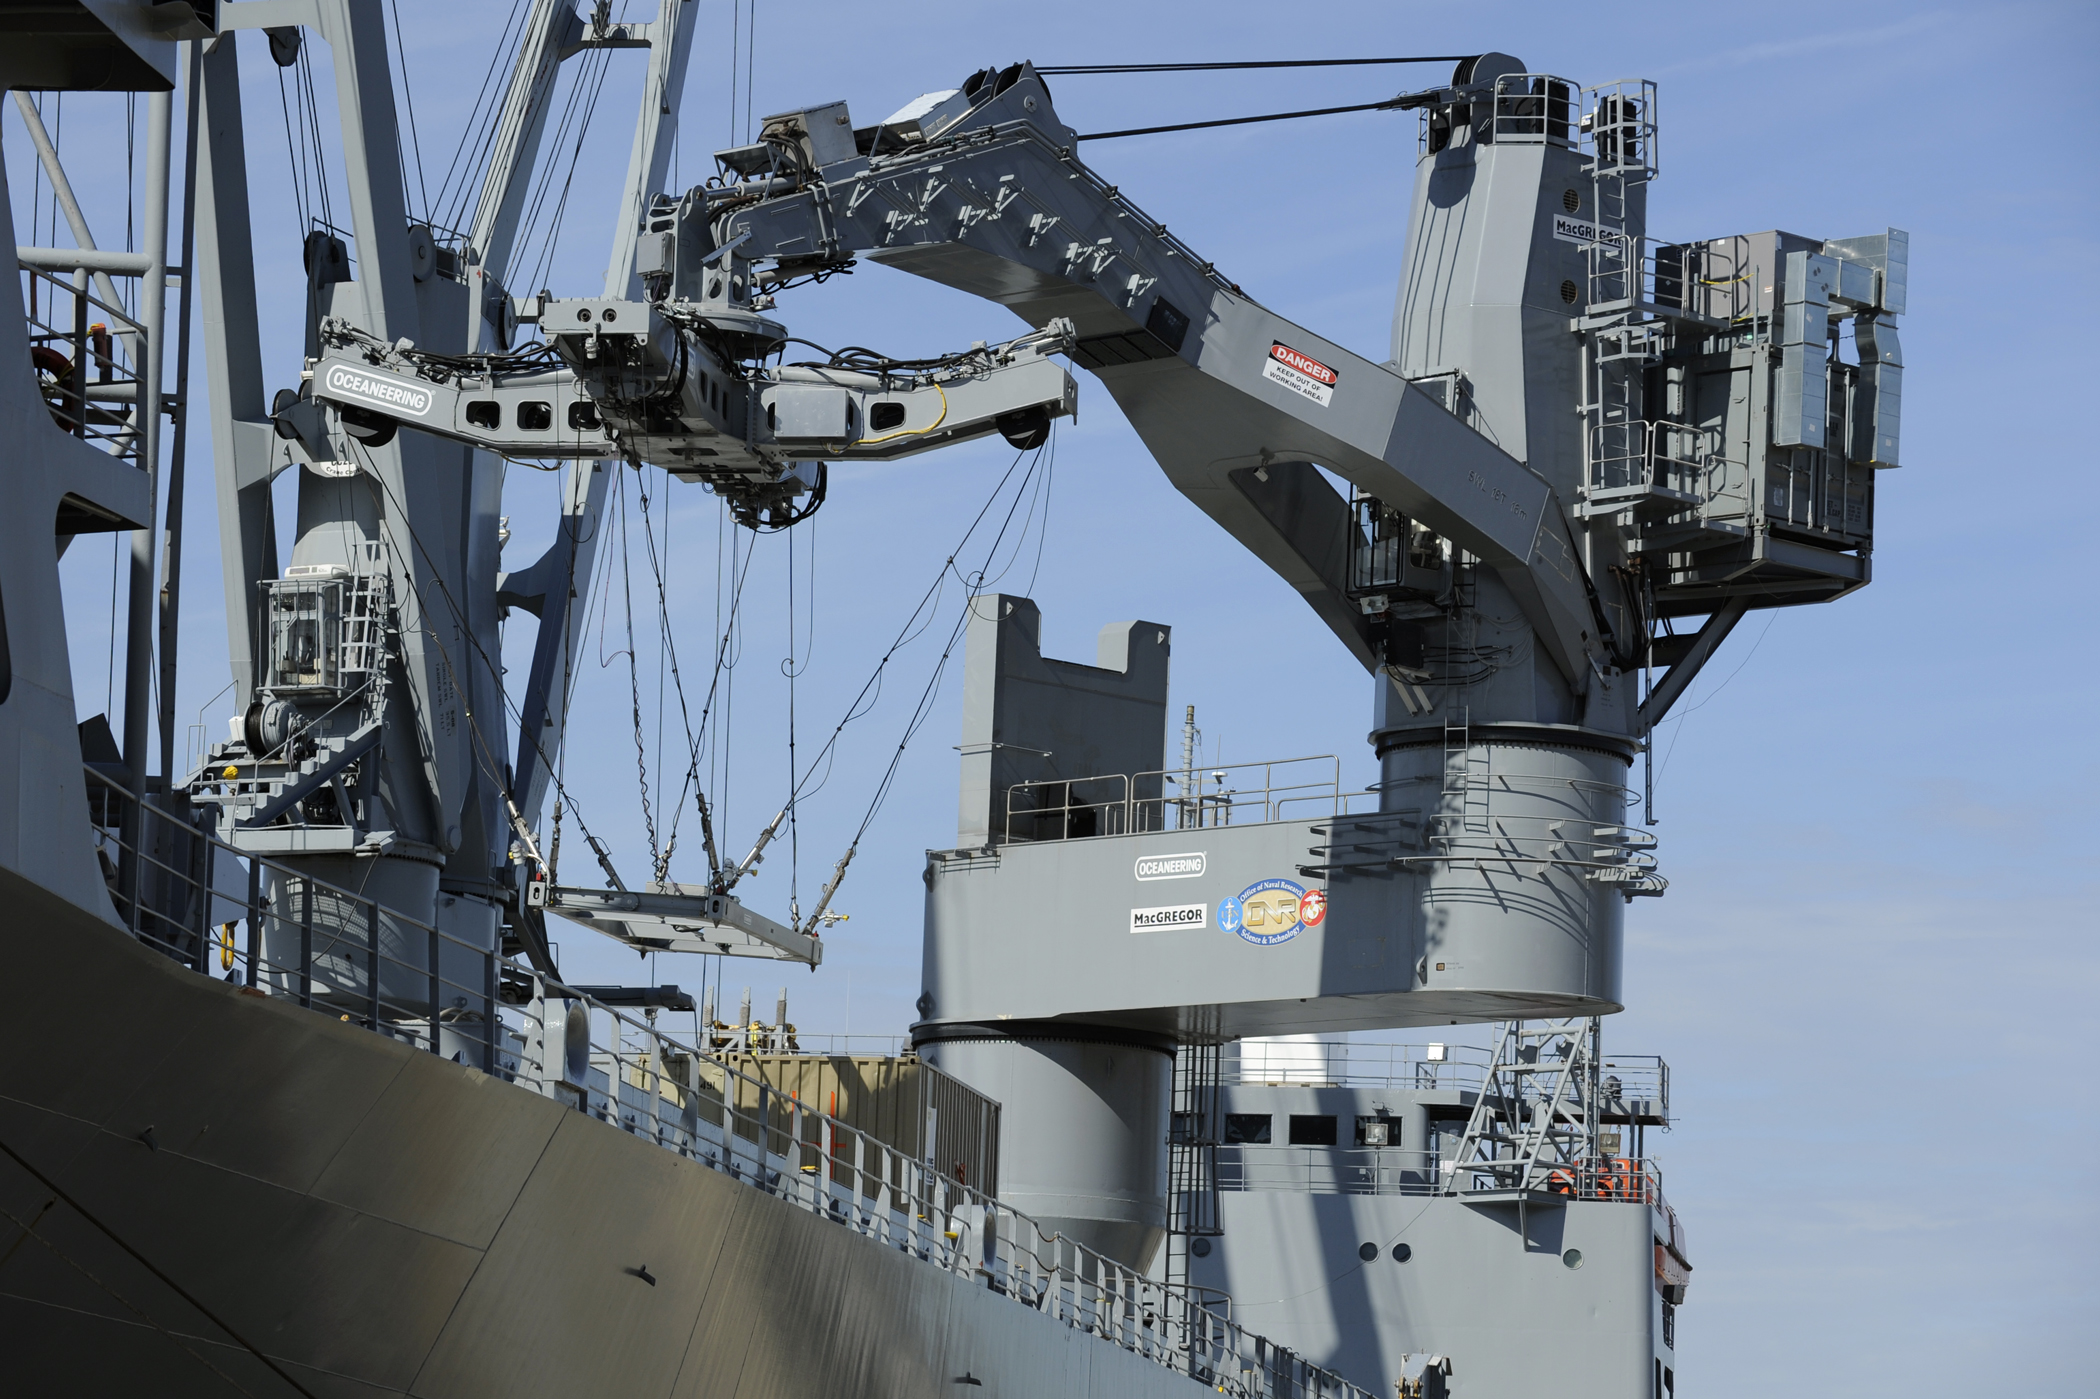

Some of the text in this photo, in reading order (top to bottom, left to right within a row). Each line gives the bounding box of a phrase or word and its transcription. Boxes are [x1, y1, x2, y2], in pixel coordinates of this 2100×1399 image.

[1276, 347, 1331, 382] DANGER
[333, 371, 426, 409] OCEANEERING
[1269, 371, 1324, 402] WORKING AREA!
[1276, 366, 1321, 392] KEEP OUT OF
[1468, 469, 1486, 493] SWL
[1139, 859, 1202, 875] OCEANEERING
[1240, 880, 1303, 903] Office of Naval Research
[1134, 909, 1202, 924] MacGREGOR
[1240, 925, 1300, 944] Science & Technology
